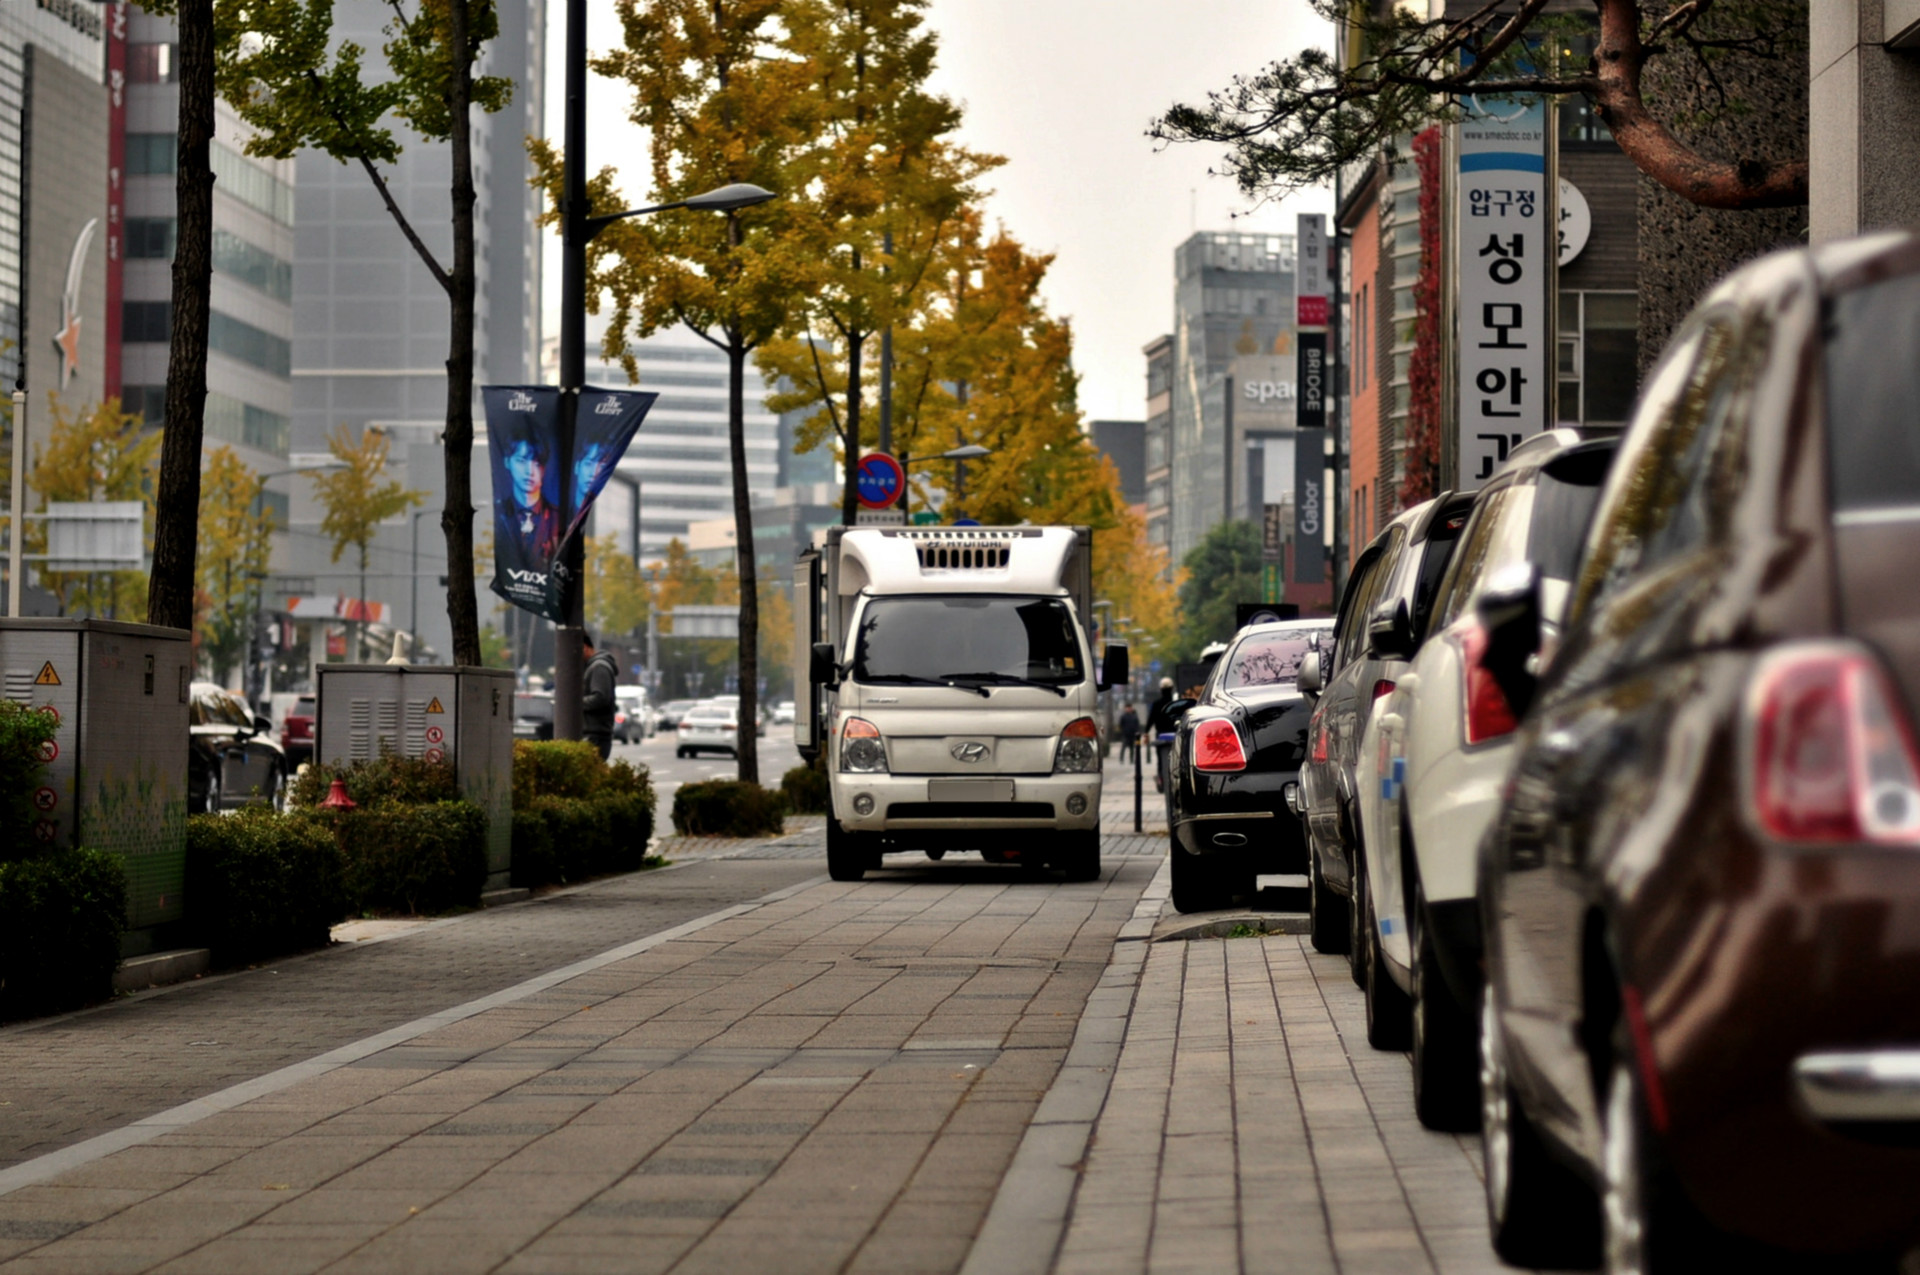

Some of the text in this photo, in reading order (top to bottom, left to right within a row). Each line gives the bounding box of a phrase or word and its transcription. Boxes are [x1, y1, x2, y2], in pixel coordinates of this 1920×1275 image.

[1469, 188, 1535, 218] 압구정
[1306, 348, 1321, 411] BRIDGE
[1301, 480, 1319, 535] Gabor
